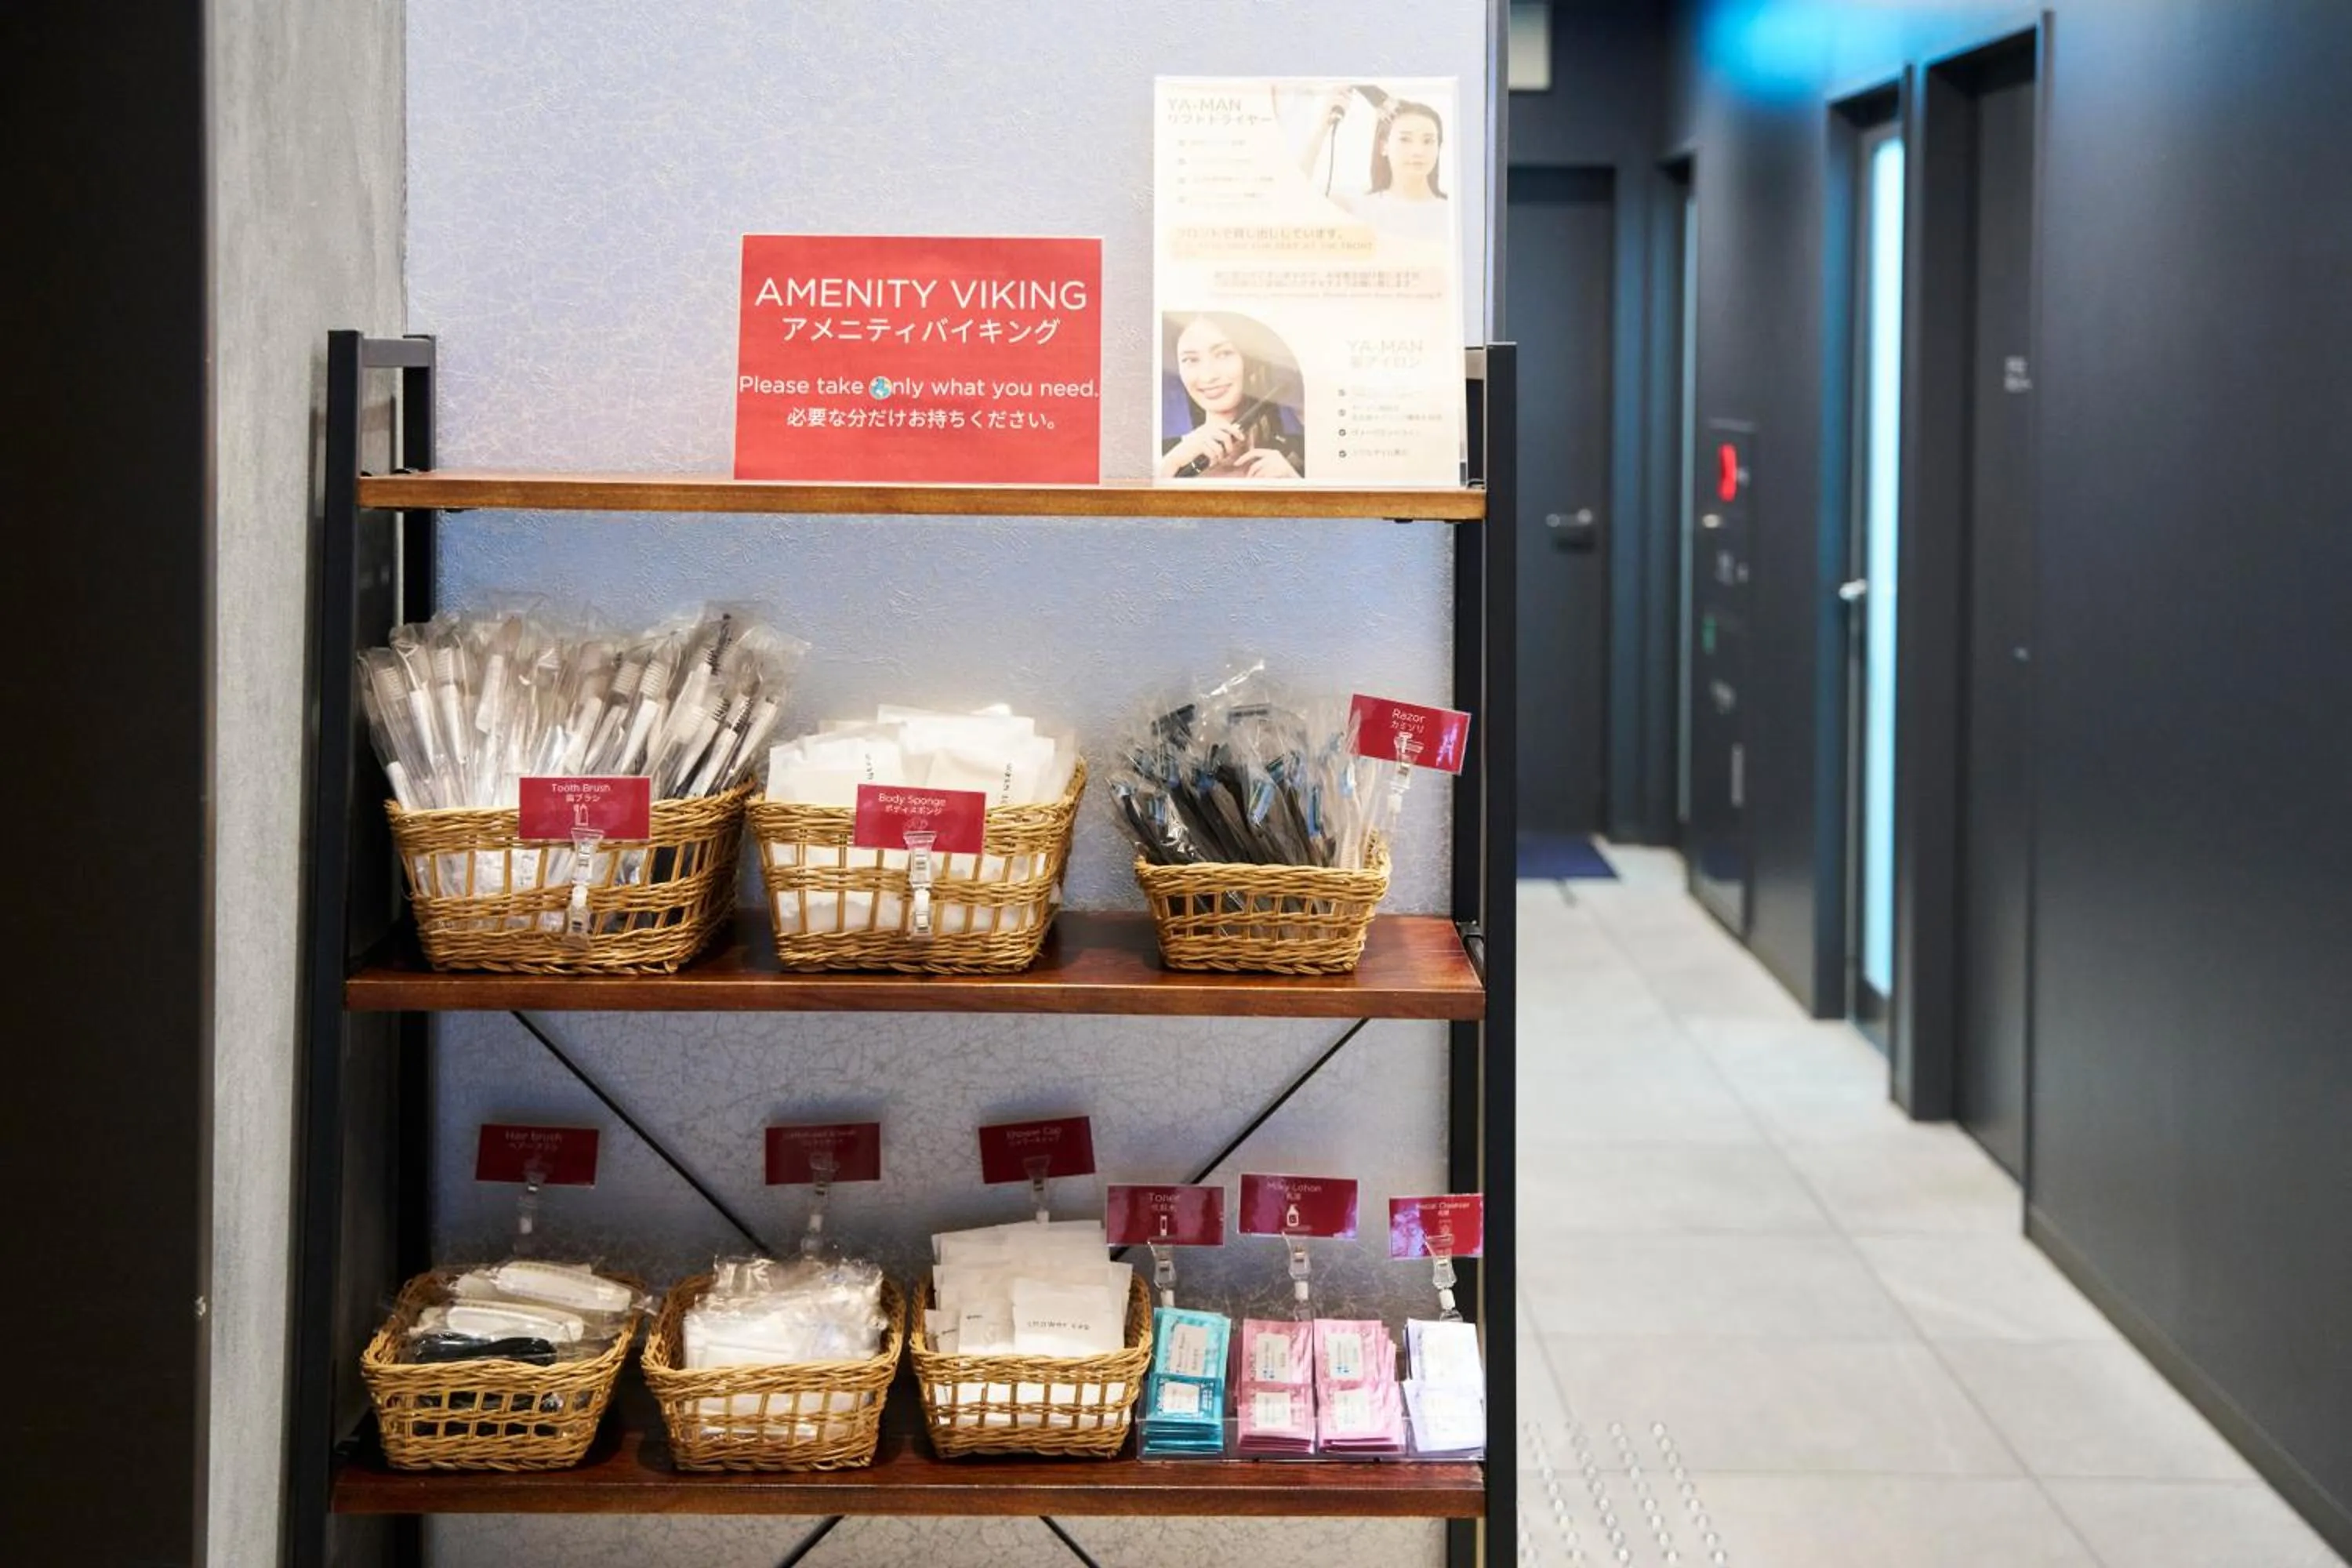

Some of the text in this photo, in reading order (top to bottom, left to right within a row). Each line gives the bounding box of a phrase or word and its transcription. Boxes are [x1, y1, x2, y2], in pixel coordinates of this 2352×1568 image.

[755, 278, 1087, 310] AMENITY VIKING
[782, 317, 1060, 345] アメニティバイキング
[739, 376, 809, 394] Please
[817, 376, 864, 395] take
[931, 378, 985, 397] what
[993, 379, 1033, 399] you
[1040, 379, 1099, 398] need.
[787, 407, 1055, 430] 必要な分だけお持ちください。
[1392, 708, 1426, 723] Razor
[552, 783, 611, 793] Tooth Brush
[879, 793, 946, 808] Body Sponge
